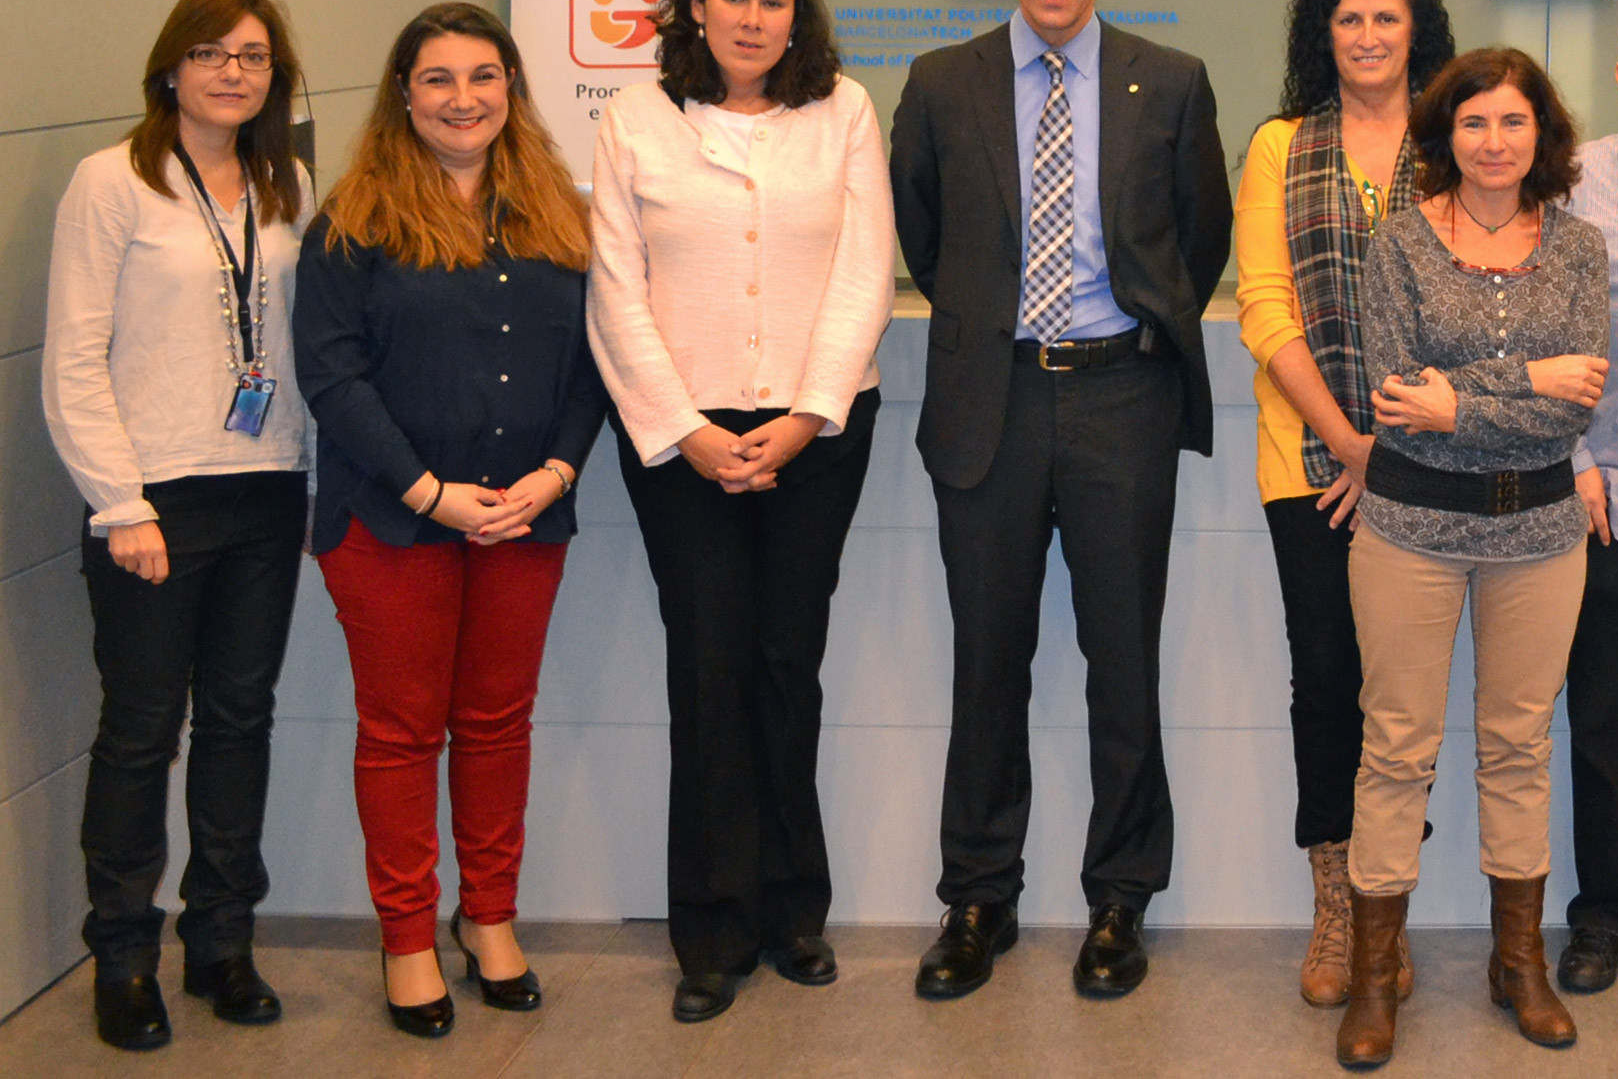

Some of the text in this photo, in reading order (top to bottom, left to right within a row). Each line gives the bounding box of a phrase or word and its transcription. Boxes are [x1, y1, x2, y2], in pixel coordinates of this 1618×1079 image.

[835, 5, 1179, 24] UNIVERSITAT POLITÈC ATALUNYA
[888, 53, 903, 66] of
[589, 108, 600, 121] e
